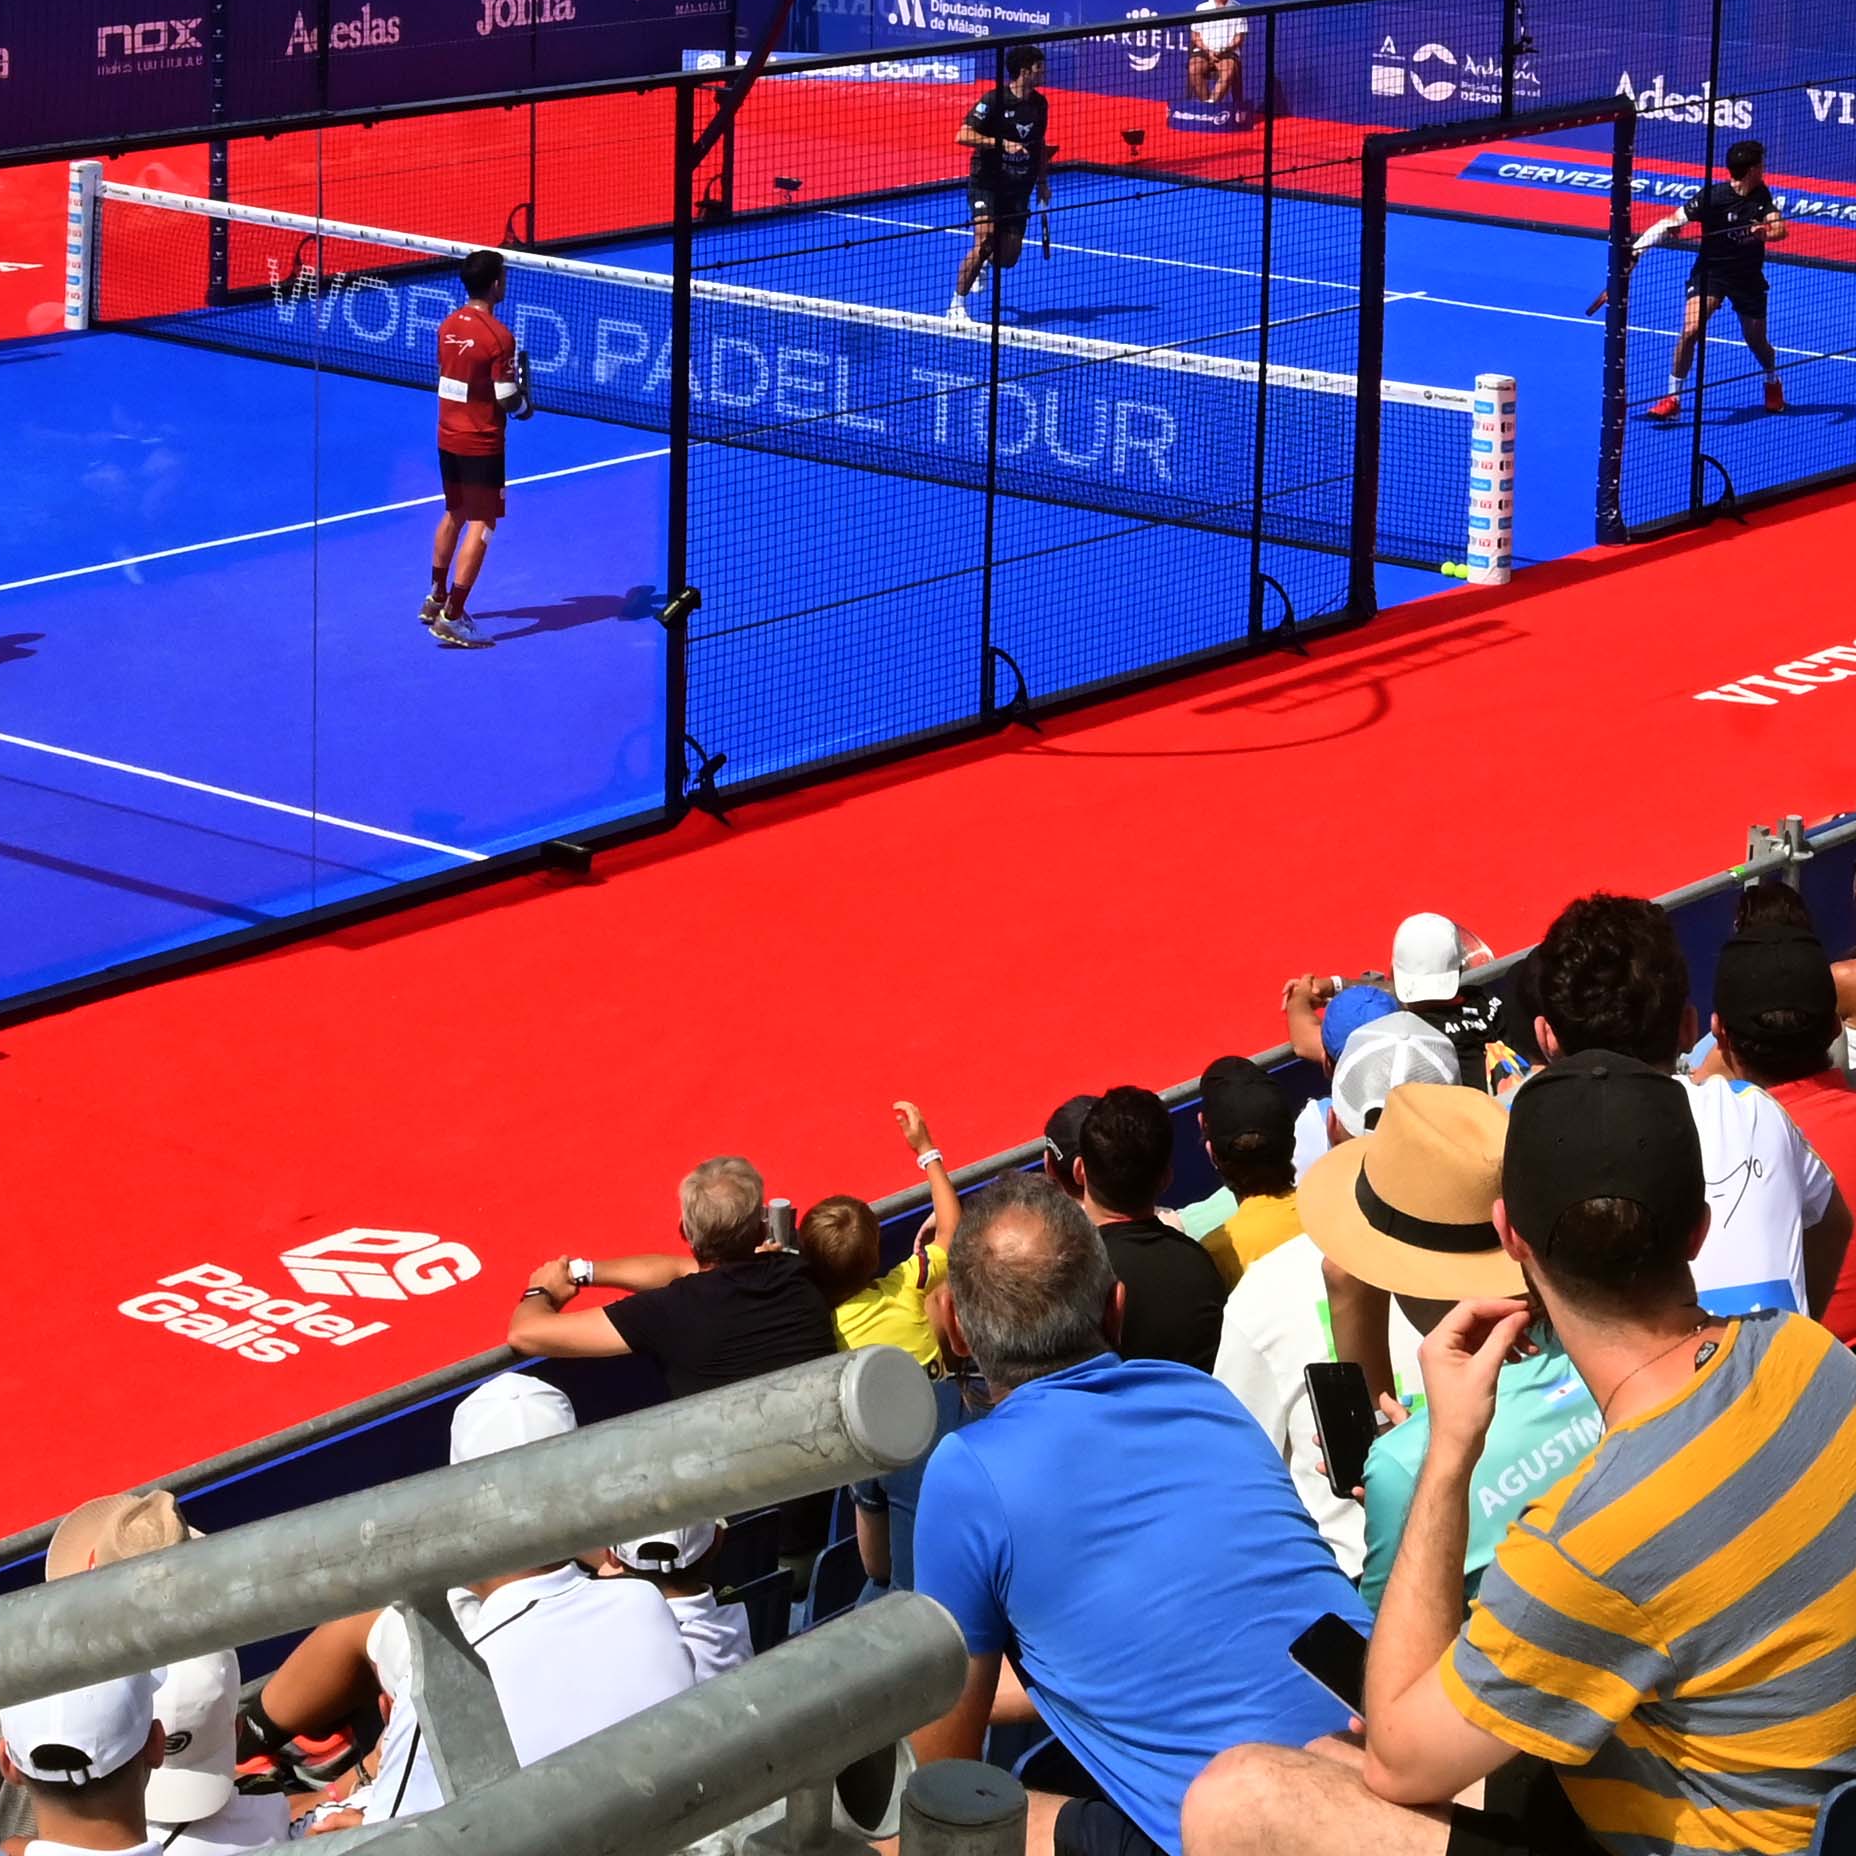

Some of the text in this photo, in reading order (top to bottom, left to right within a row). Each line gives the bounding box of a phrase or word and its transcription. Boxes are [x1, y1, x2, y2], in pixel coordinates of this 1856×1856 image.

[930, 18, 989, 38] de Málaga
[993, 6, 1050, 26] Provincial
[870, 60, 960, 80] Courts
[1616, 70, 1753, 129] Adeslas
[1498, 163, 1649, 193] CERVEZAS
[594, 312, 886, 434] PADEL
[911, 366, 1178, 481] TOUR
[116, 1290, 300, 1364] Galis
[157, 1261, 390, 1348] Padel
[1477, 1412, 1604, 1519] AGUSTÍN
